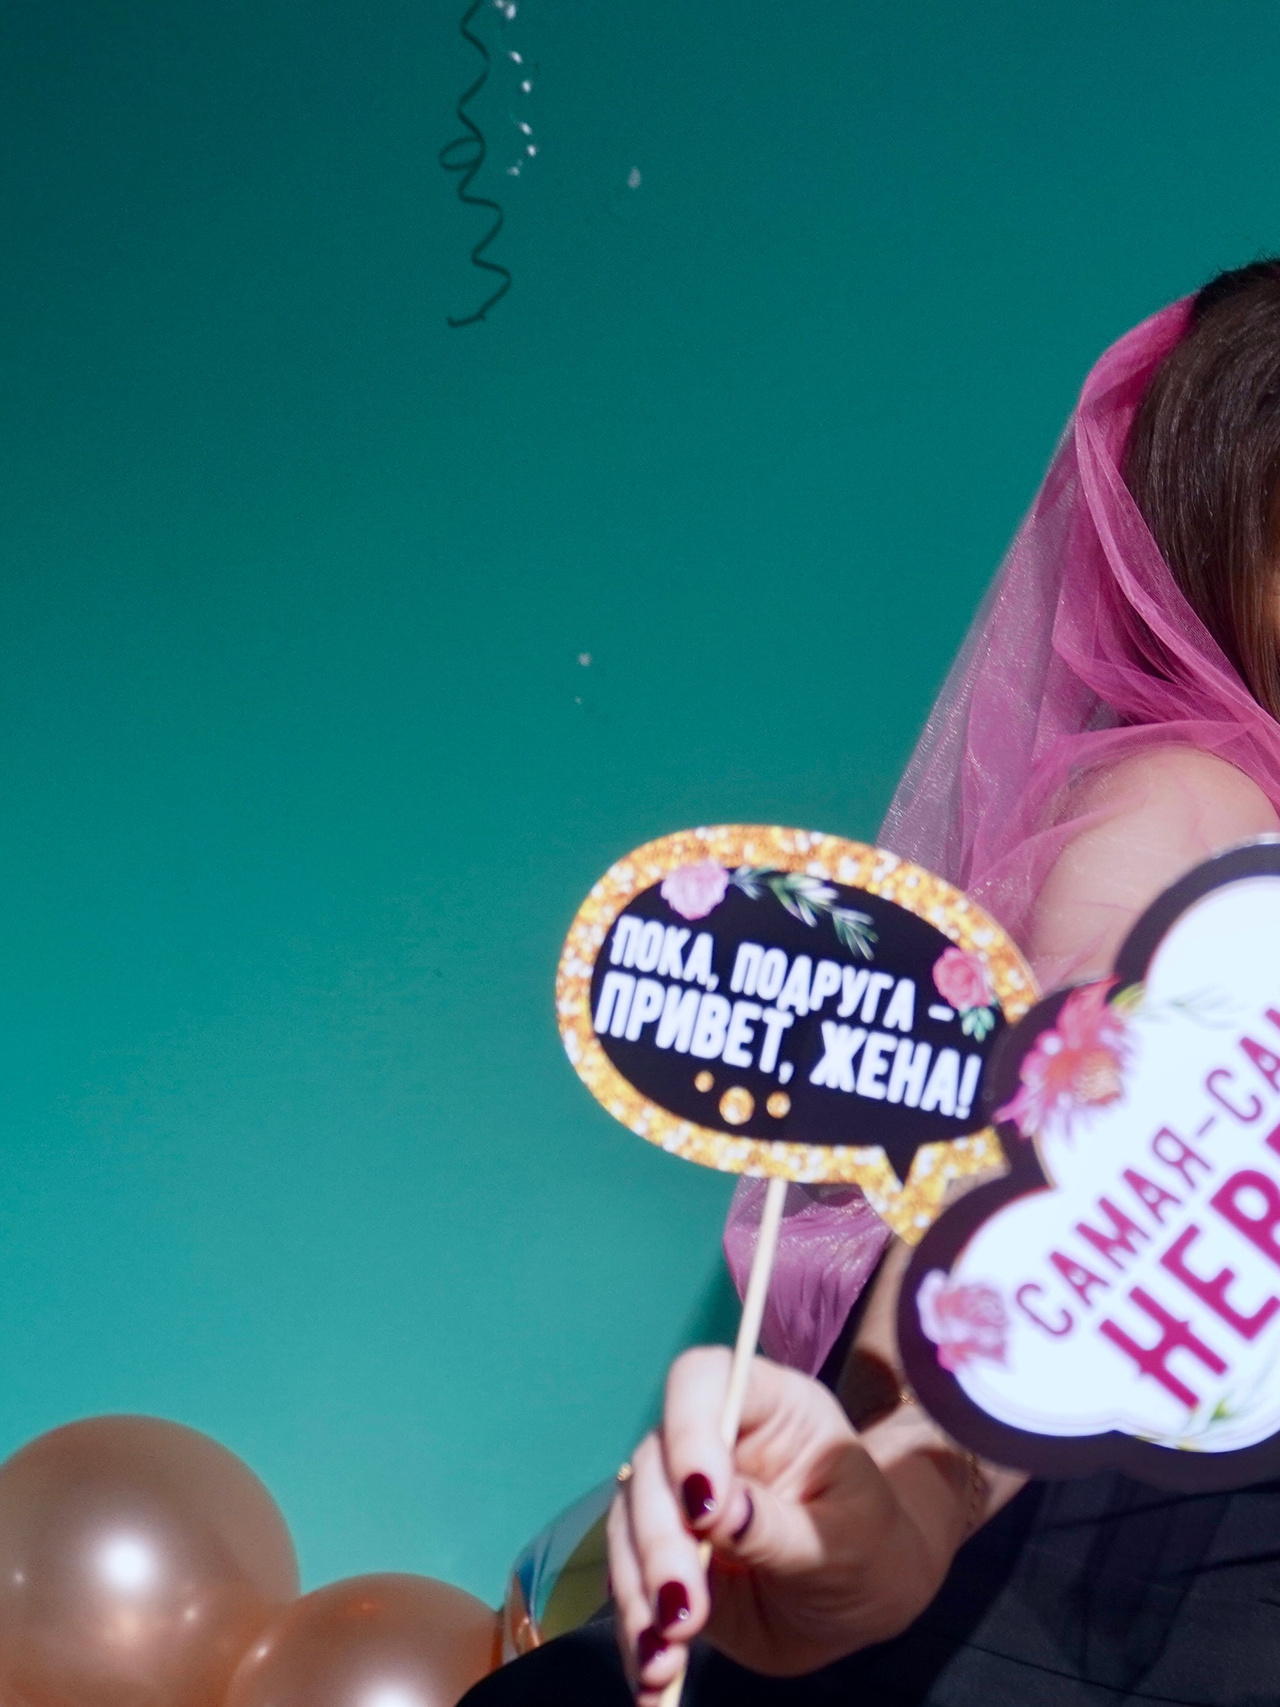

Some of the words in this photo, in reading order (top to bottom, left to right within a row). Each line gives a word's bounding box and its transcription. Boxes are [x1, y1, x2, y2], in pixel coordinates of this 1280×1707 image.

[610, 915, 719, 991] ПОКА,
[730, 942, 915, 1034] ПОДРУГА
[594, 971, 795, 1085] ПРИВЕТ,
[809, 1020, 983, 1120] ЖЕНА!
